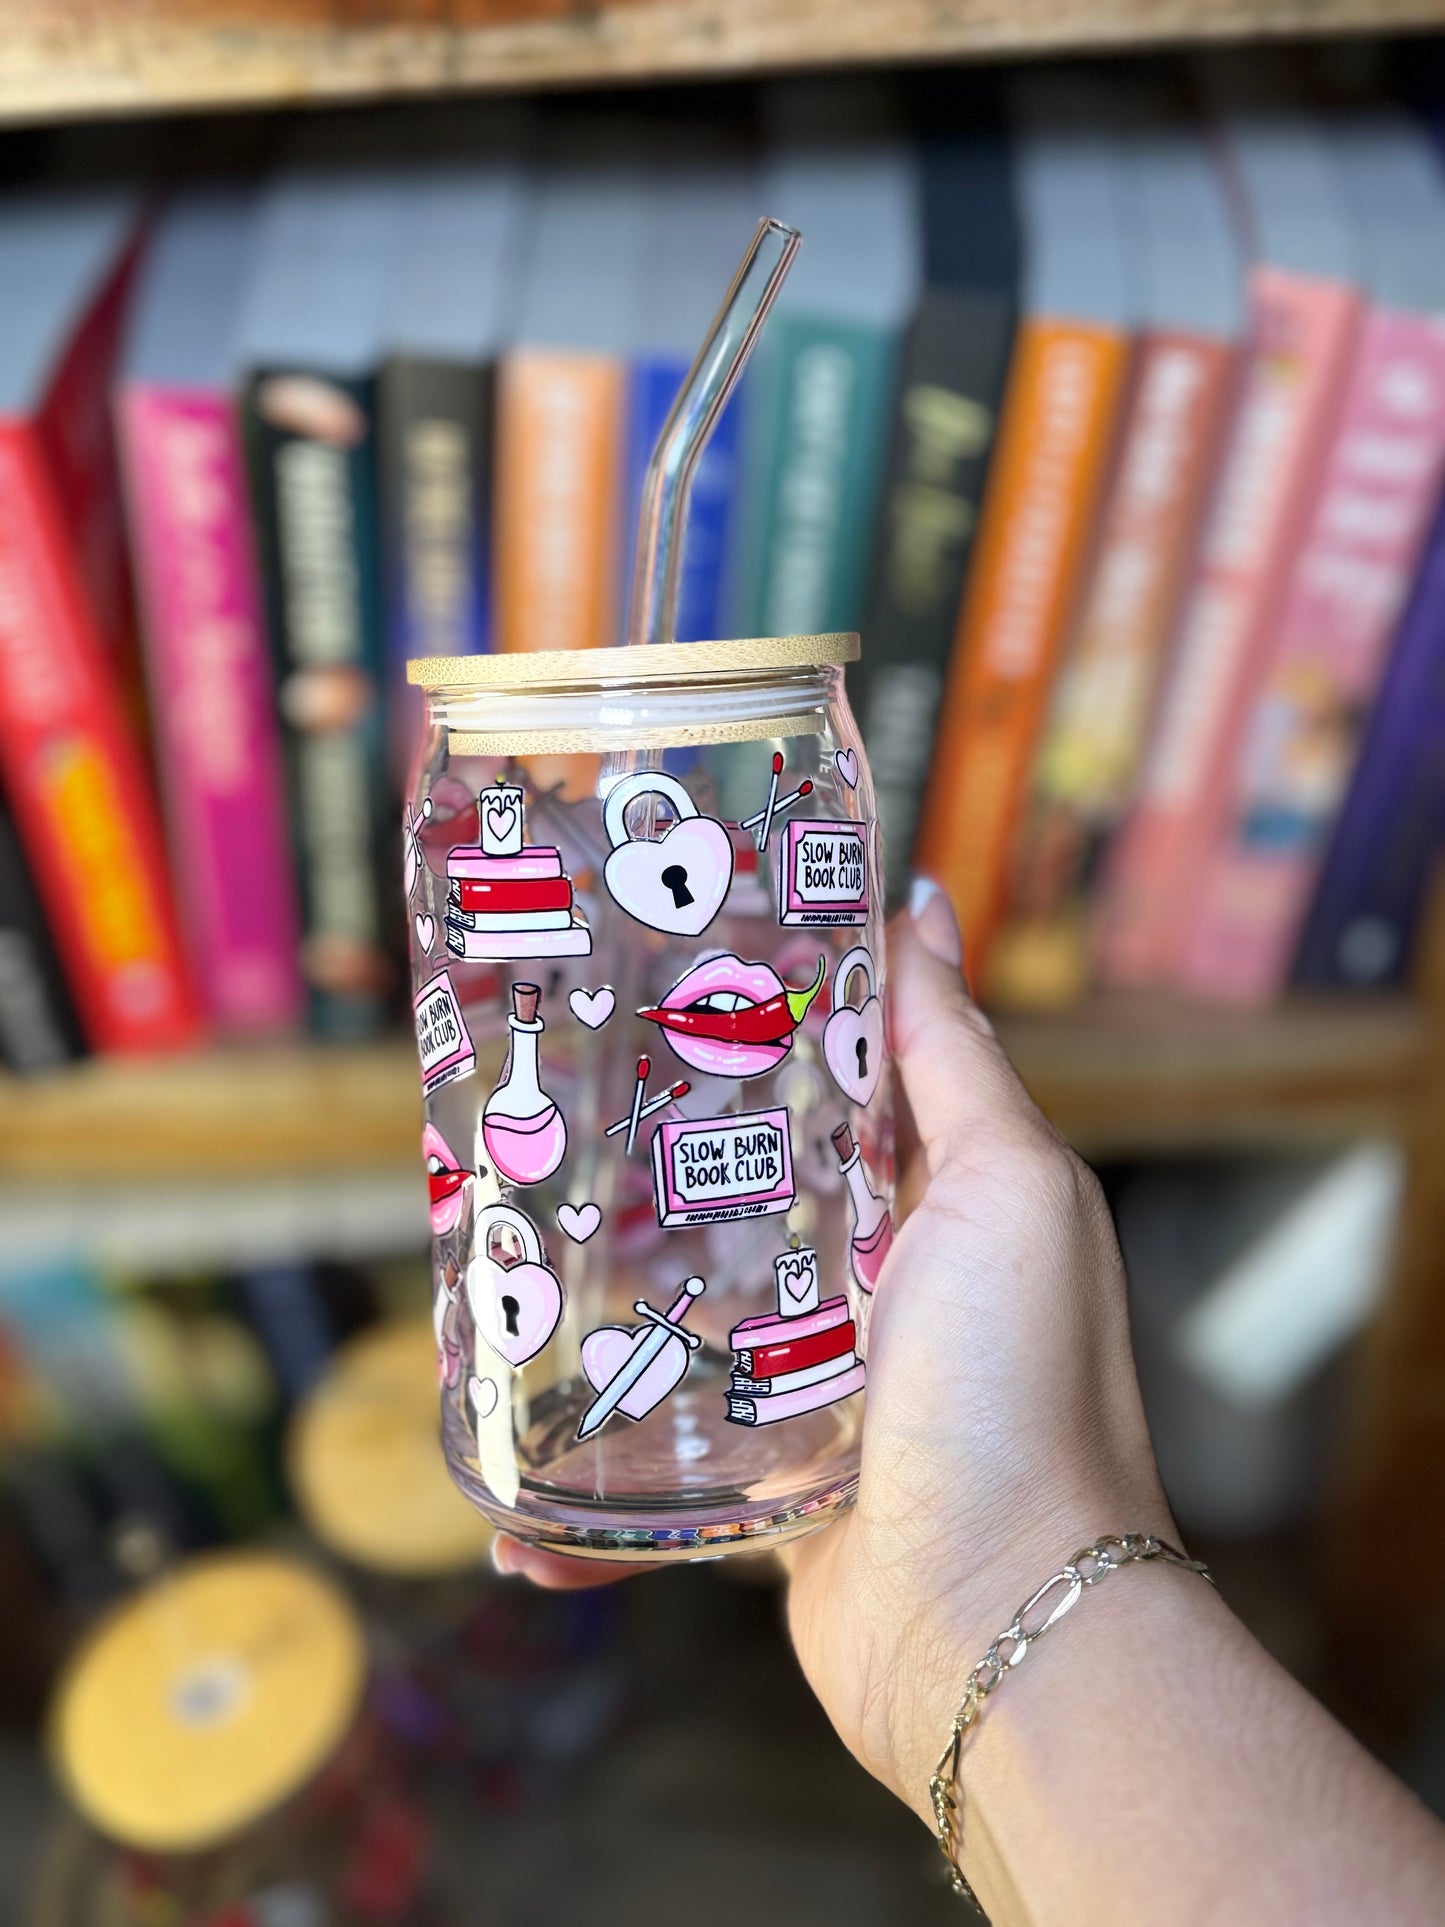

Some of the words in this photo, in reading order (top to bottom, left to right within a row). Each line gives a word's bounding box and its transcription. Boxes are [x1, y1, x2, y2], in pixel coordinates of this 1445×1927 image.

[802, 841, 834, 864] SLOW
[838, 842, 863, 866] BURN
[804, 865, 836, 890] BOOK
[838, 866, 862, 891] CLUB
[428, 995, 452, 1027] BURN
[434, 1018, 457, 1048] CLUB
[679, 1138, 726, 1164] SLOW
[734, 1132, 779, 1160] BURN
[684, 1162, 732, 1189] BOOK
[735, 1156, 778, 1182] CLUB
